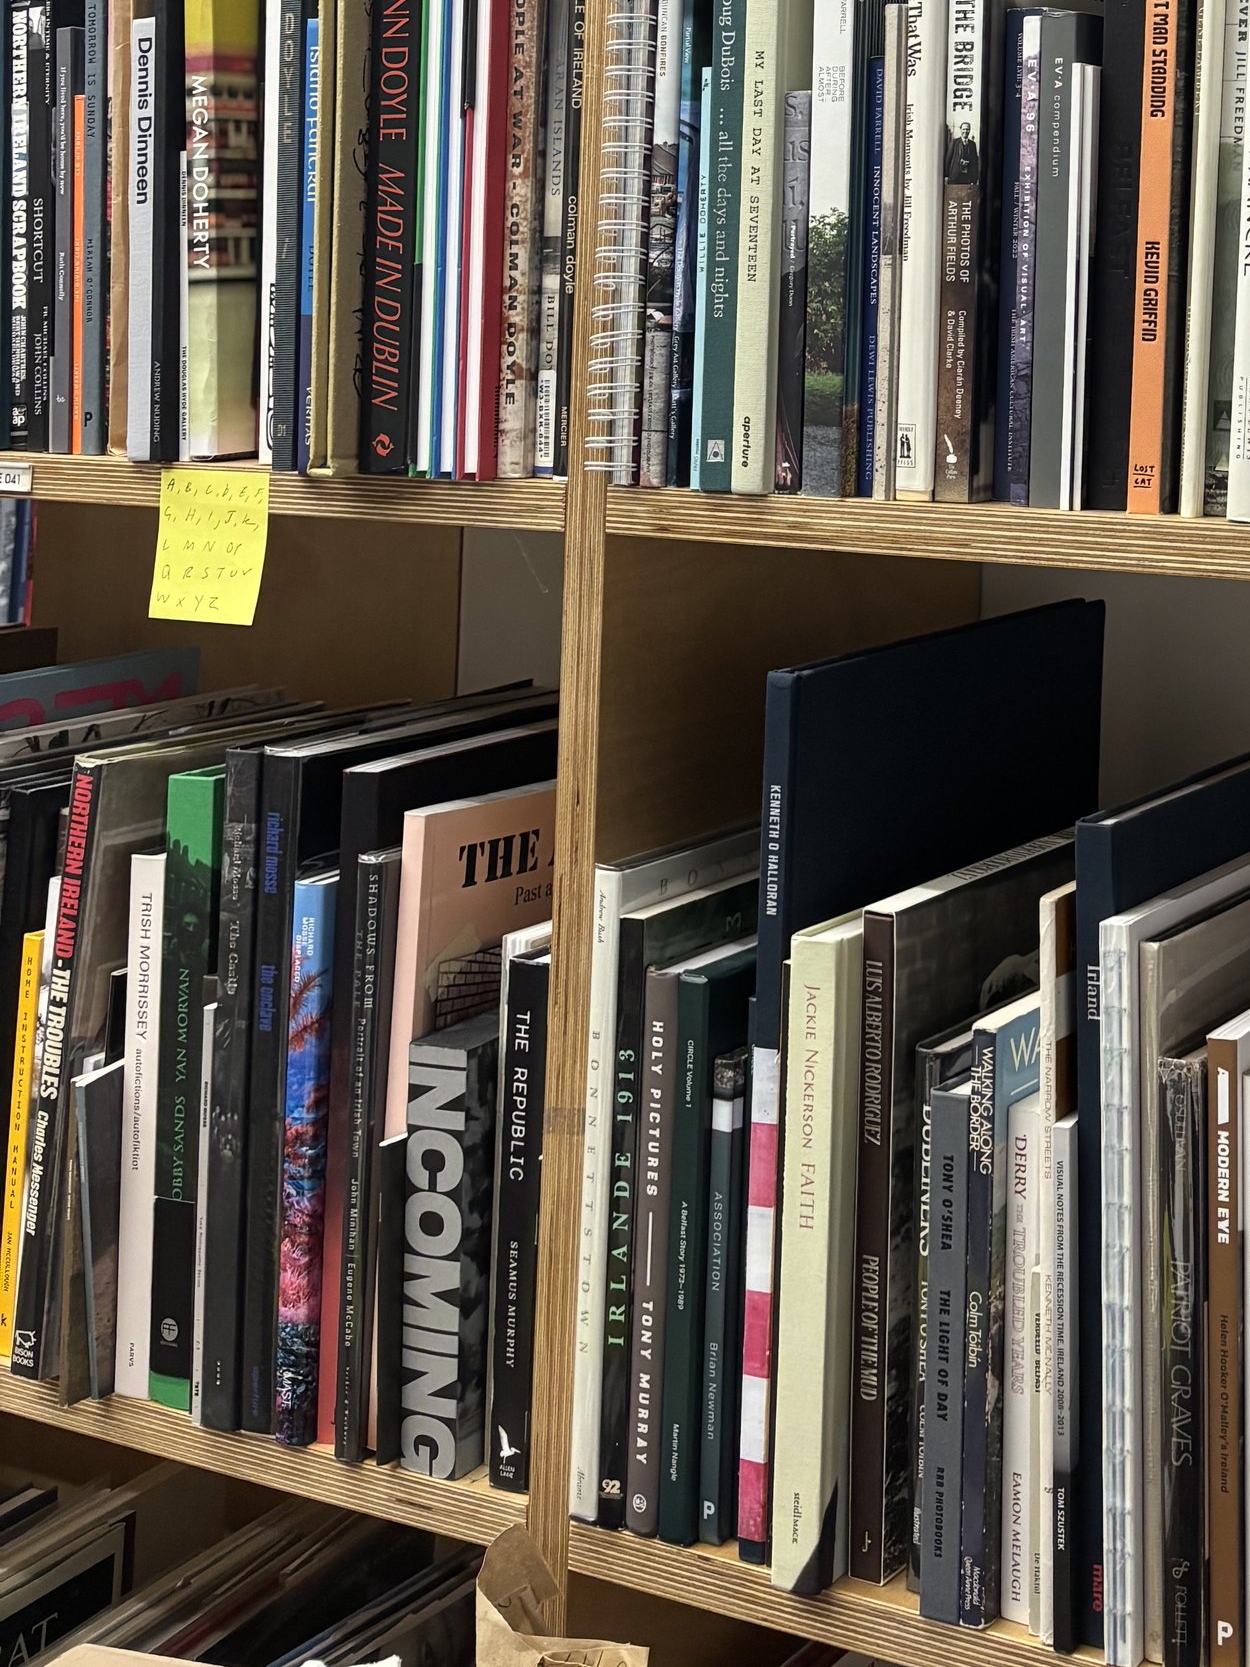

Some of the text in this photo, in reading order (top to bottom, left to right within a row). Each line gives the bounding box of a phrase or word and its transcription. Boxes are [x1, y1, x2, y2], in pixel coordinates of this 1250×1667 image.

[134, 37, 152, 204] Dennis Dinneen
[380, 47, 408, 141] DOYLE
[951, 39, 974, 113] BRIDGE
[190, 75, 210, 269] MEGAN DOHERTY
[376, 163, 406, 252] MADE
[374, 257, 404, 292] IN
[371, 298, 403, 411] DUBLIN
[134, 892, 153, 1041] TRISH MORRISSEY
[507, 1010, 531, 1182] THE REPUBLIC
[796, 1163, 817, 1231] FAITH
[398, 1048, 469, 1482] INCOMING
